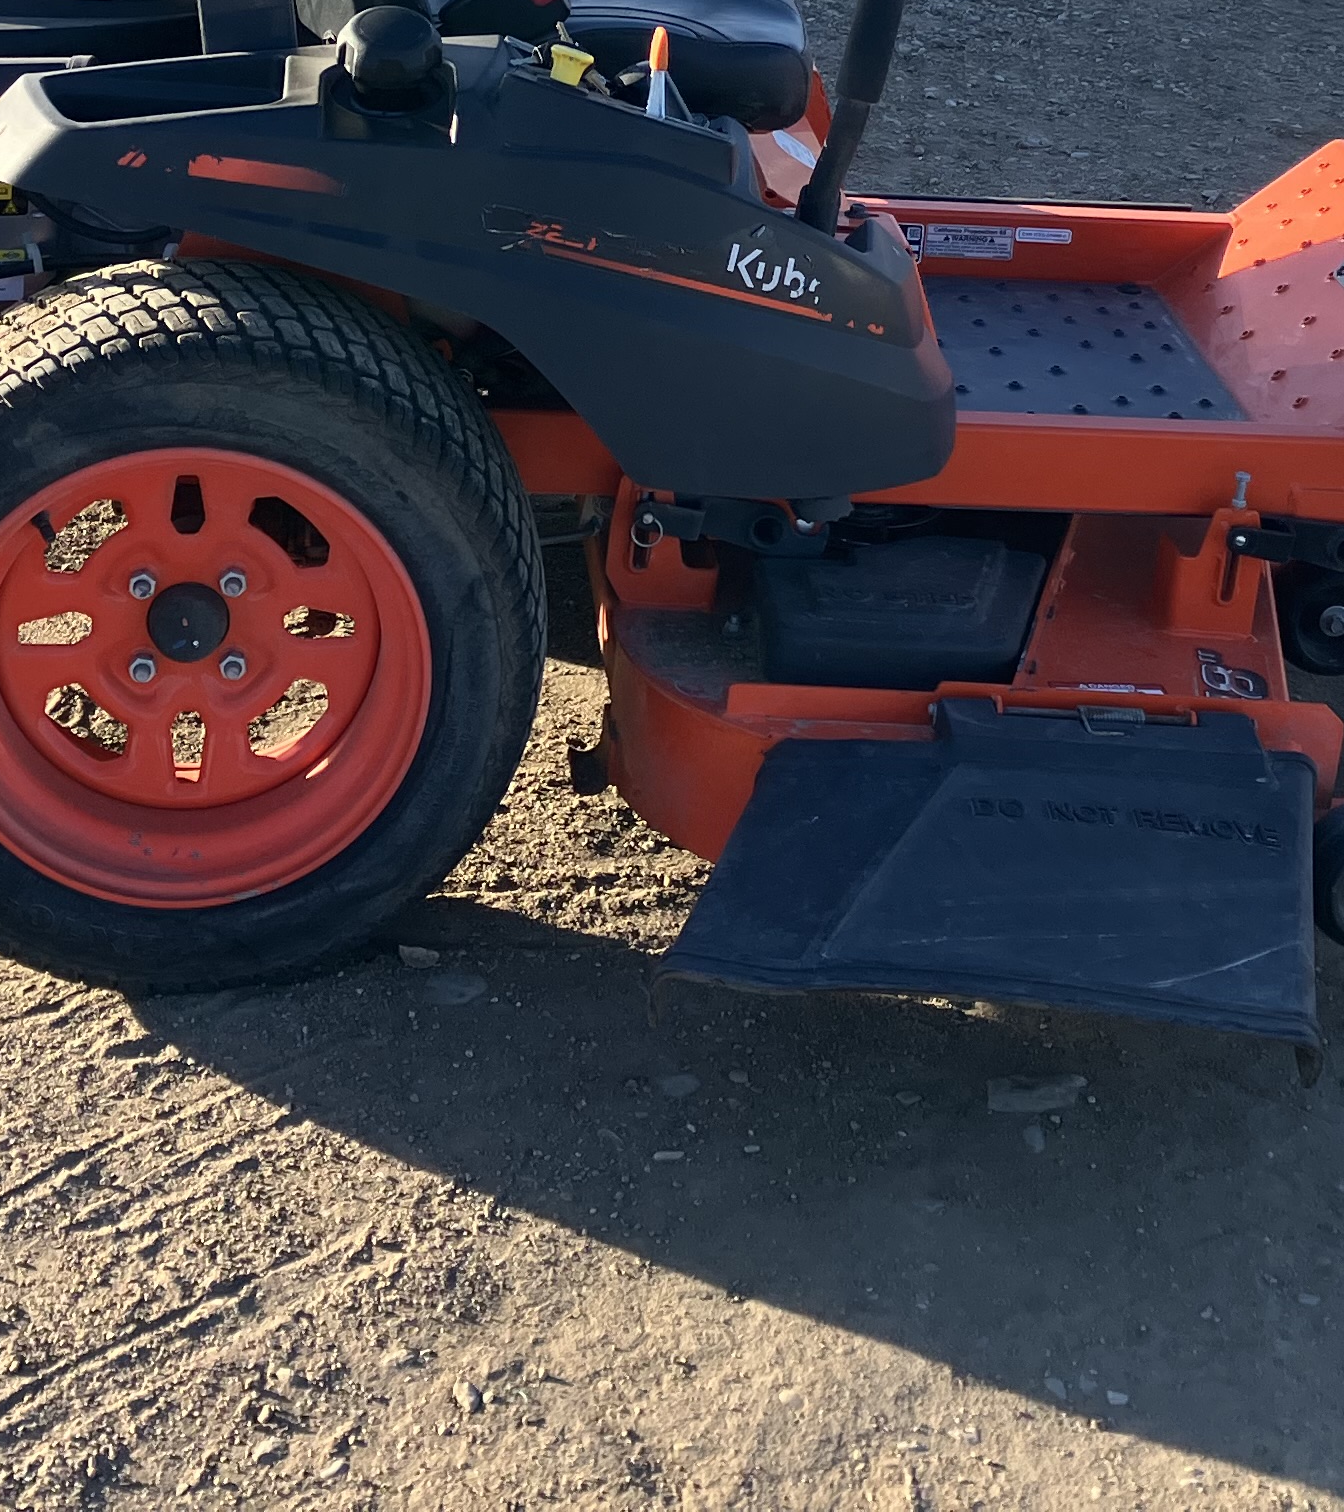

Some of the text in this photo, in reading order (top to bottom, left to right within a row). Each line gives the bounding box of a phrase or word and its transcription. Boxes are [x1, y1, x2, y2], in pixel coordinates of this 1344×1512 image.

[968, 796, 1282, 850] DO NOT REMOVE
